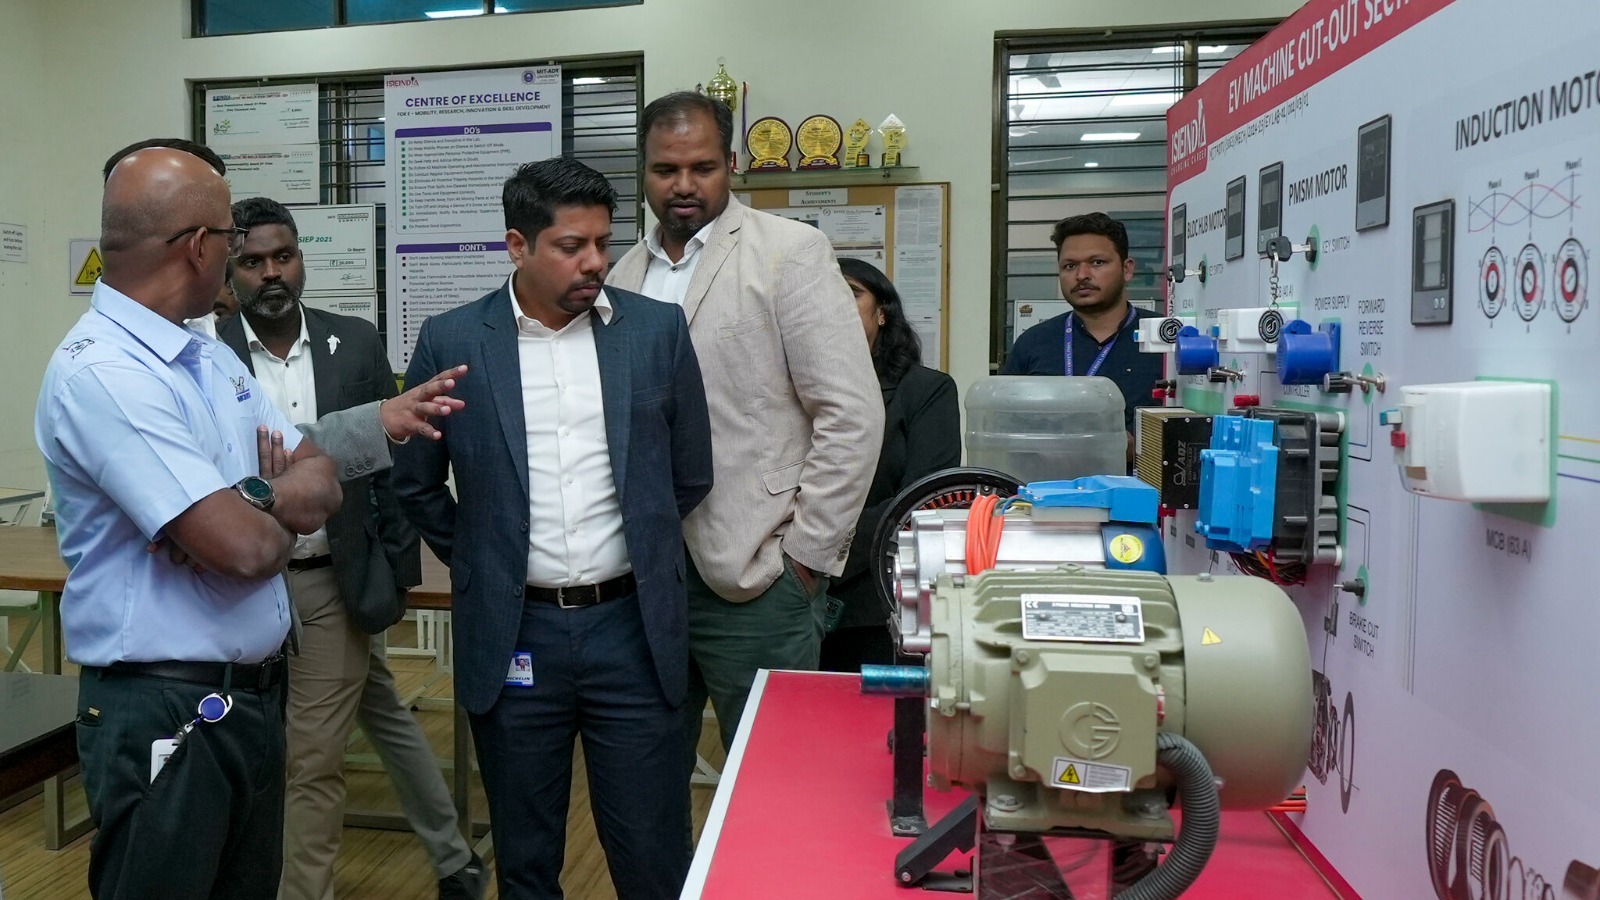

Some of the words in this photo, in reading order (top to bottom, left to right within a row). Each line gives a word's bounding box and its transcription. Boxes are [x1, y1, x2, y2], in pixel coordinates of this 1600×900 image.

[1229, 78, 1241, 113] EV
[1243, 39, 1295, 106] MACHINE
[1298, 0, 1359, 70] CUT-OUT
[406, 97, 449, 107] CENTRE
[452, 96, 466, 104] OF
[470, 92, 540, 104] EXCELLENCE
[1455, 89, 1544, 152] INDUCTION
[1289, 178, 1313, 206] PMSM
[1315, 164, 1348, 198] MOTOR
[1187, 218, 1198, 239] BLDC
[1199, 213, 1208, 236] HUB
[1322, 241, 1330, 254] KEY
[1331, 236, 1350, 252] SWITCH
[1315, 297, 1331, 310] POWER
[1332, 295, 1350, 309] SUPPLY
[1359, 298, 1385, 314] FORWARD
[1359, 320, 1384, 335] REVERSE
[1361, 342, 1381, 356] SWITCH
[1486, 528, 1505, 550] MCB
[1507, 536, 1519, 557] (63
[1522, 539, 1532, 563] A)
[1349, 611, 1366, 633] BRAKE
[1368, 621, 1379, 640] CUT
[1353, 634, 1374, 659] SWITCH
